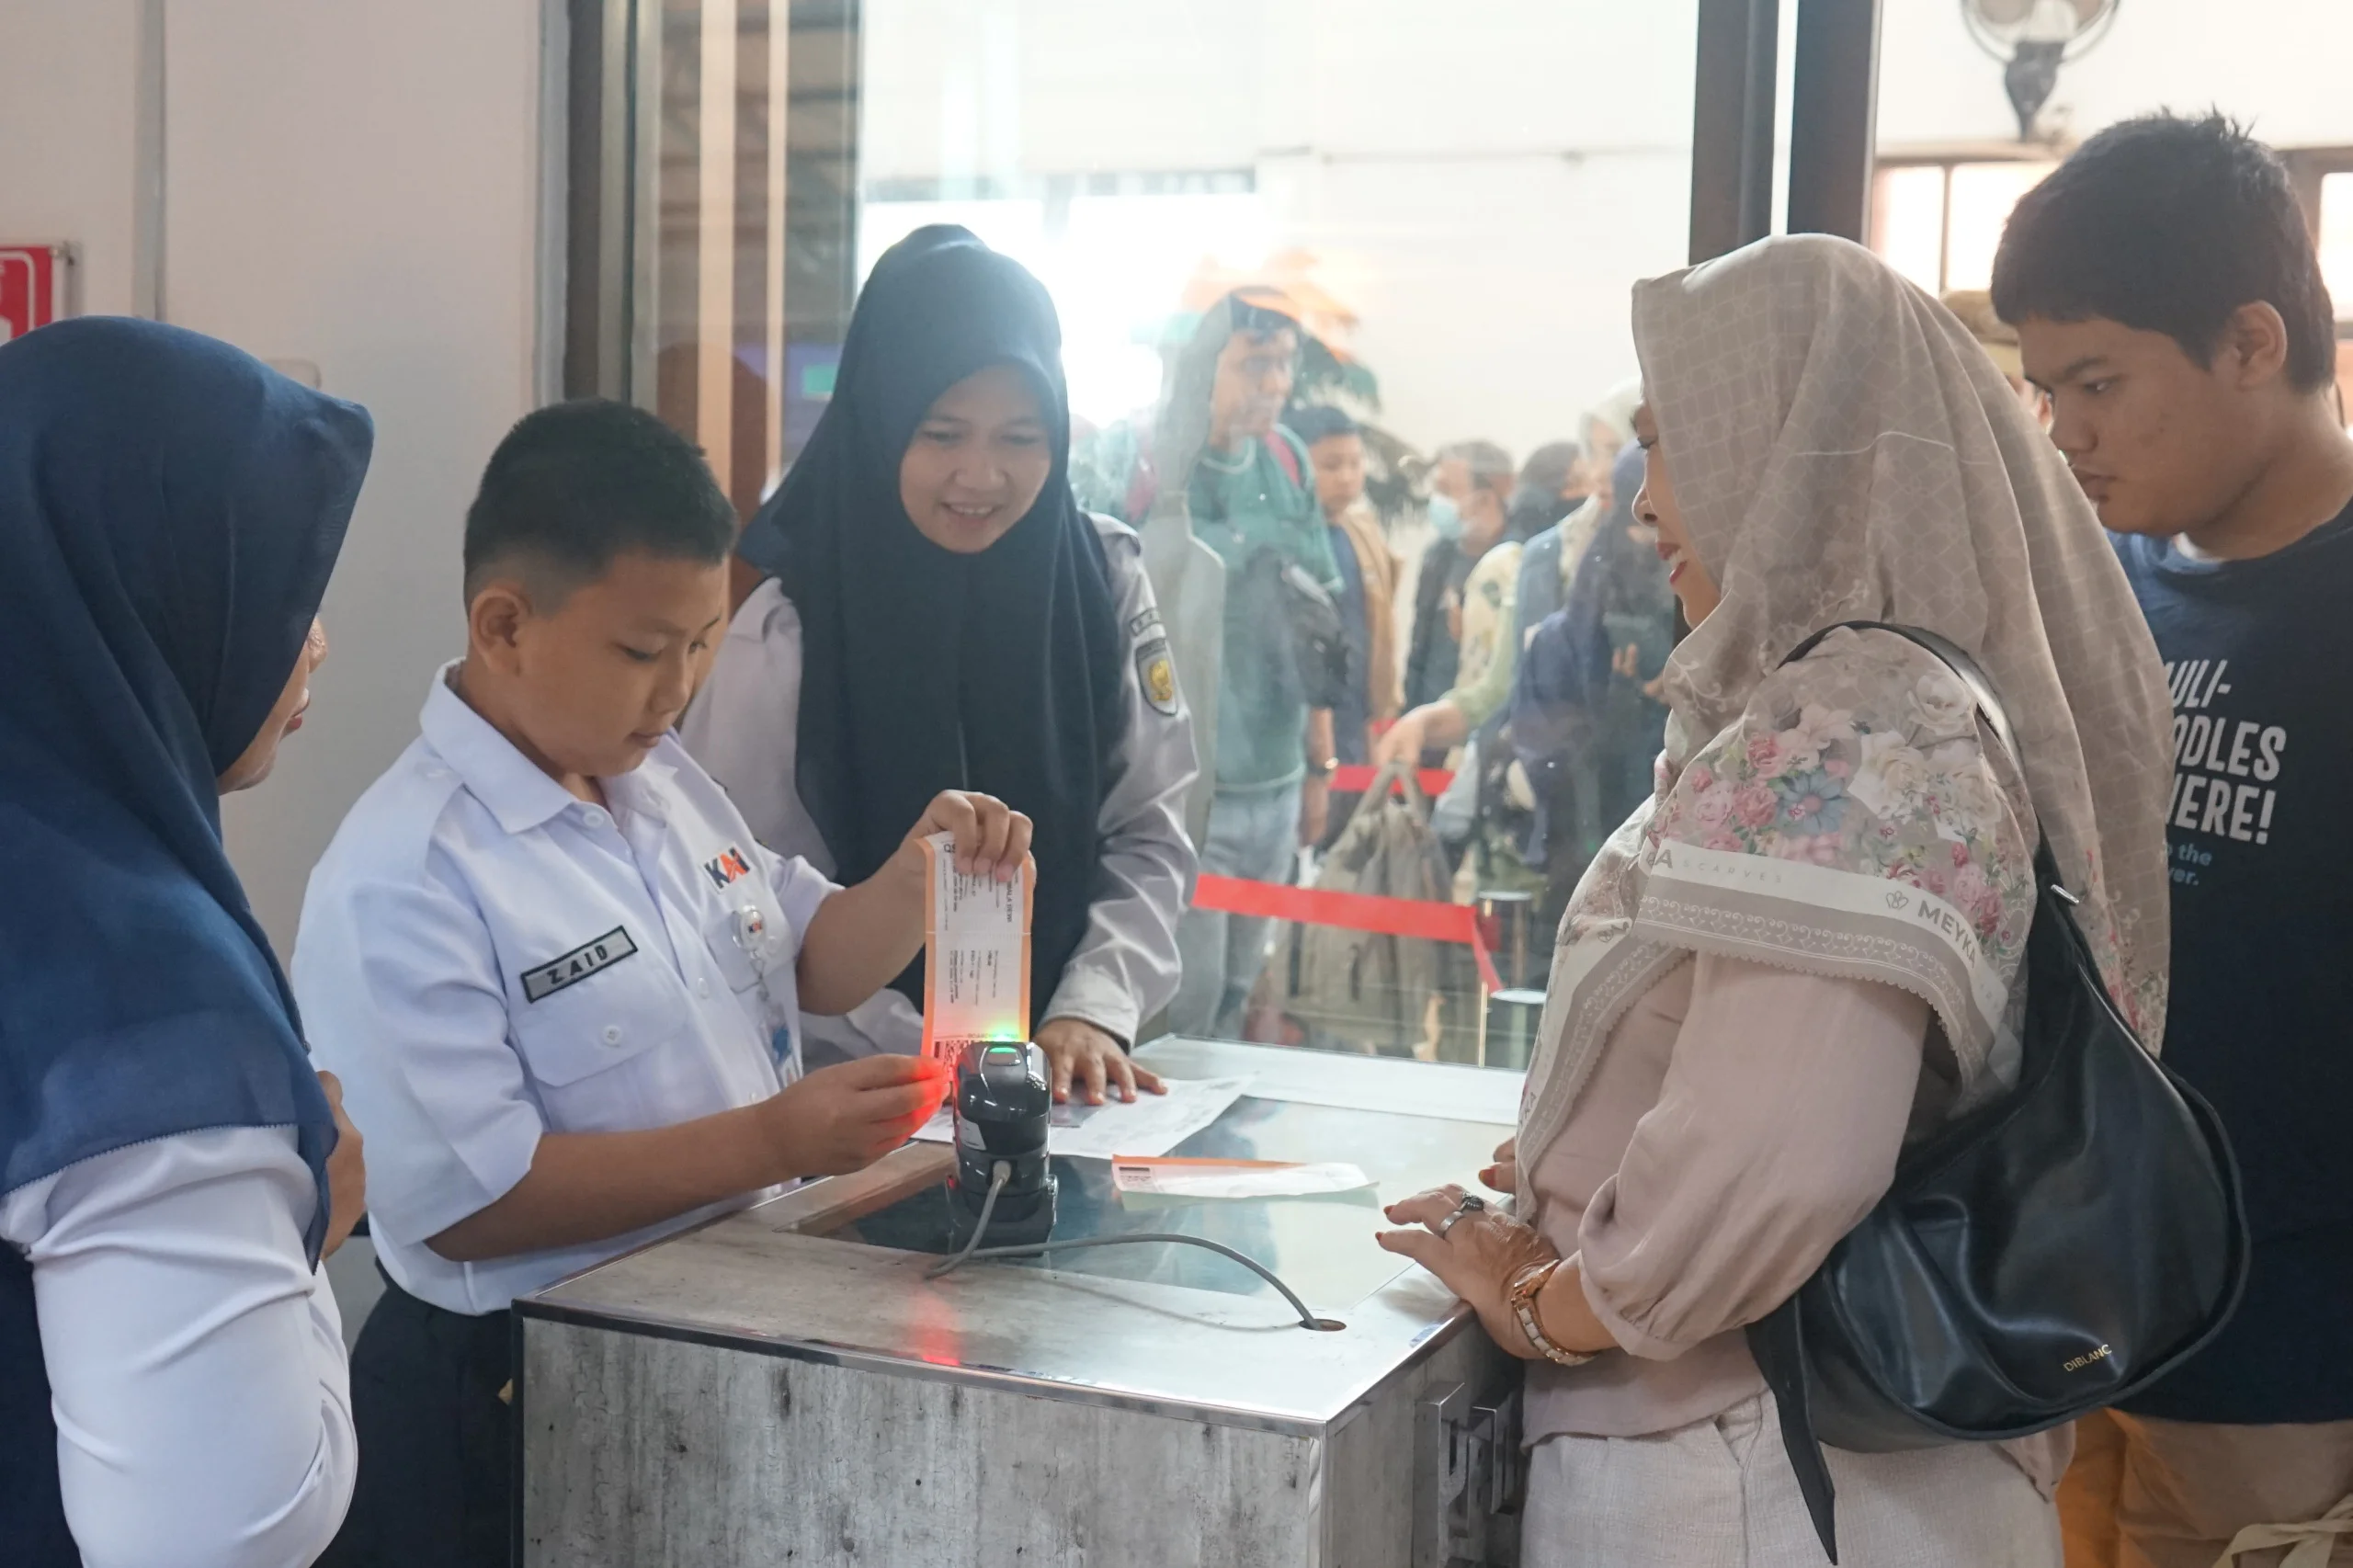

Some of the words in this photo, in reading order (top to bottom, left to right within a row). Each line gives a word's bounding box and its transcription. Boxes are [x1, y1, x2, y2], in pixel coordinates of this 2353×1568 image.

[2177, 843, 2212, 866] the
[1917, 900, 1975, 969] MEYKA
[546, 945, 608, 984] ZAID
[2063, 1344, 2112, 1372] DIBLANC
